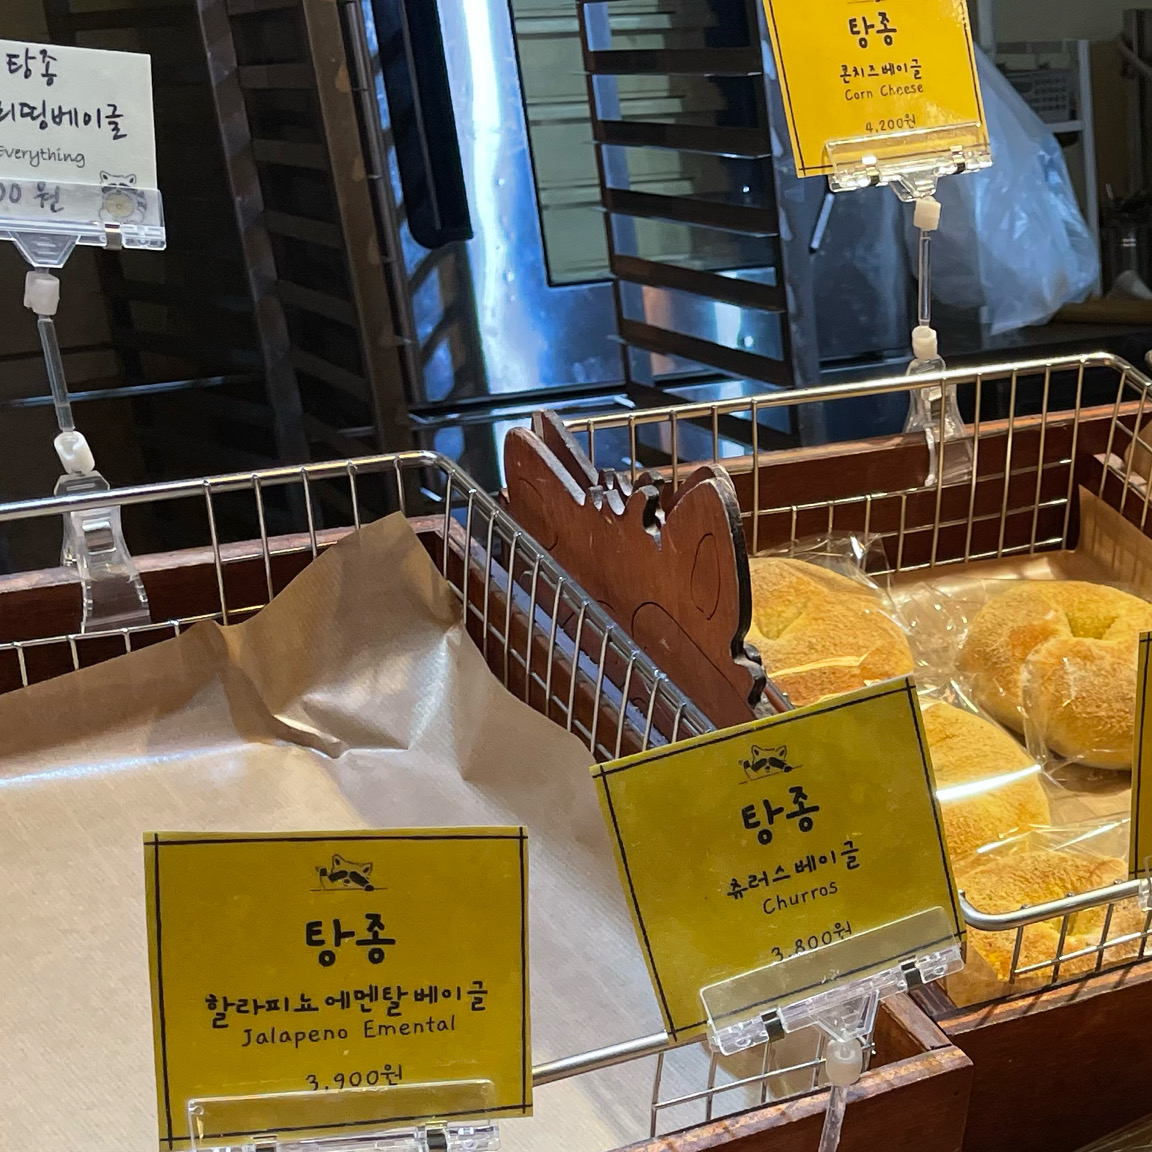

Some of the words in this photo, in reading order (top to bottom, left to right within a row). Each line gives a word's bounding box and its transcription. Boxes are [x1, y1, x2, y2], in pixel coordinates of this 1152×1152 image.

[848, 11, 897, 49] 탕종
[6, 47, 57, 87] 탕종
[839, 58, 922, 84] 콘치즈베이글
[844, 87, 874, 102] Corn
[880, 83, 924, 97] Cheese
[741, 785, 820, 846] 탕종
[726, 840, 859, 901] 츄러스베이글
[762, 880, 838, 916] Churros
[305, 912, 396, 967] 탕종
[241, 1025, 348, 1049] Jalapeno
[363, 1015, 456, 1038] Emental
